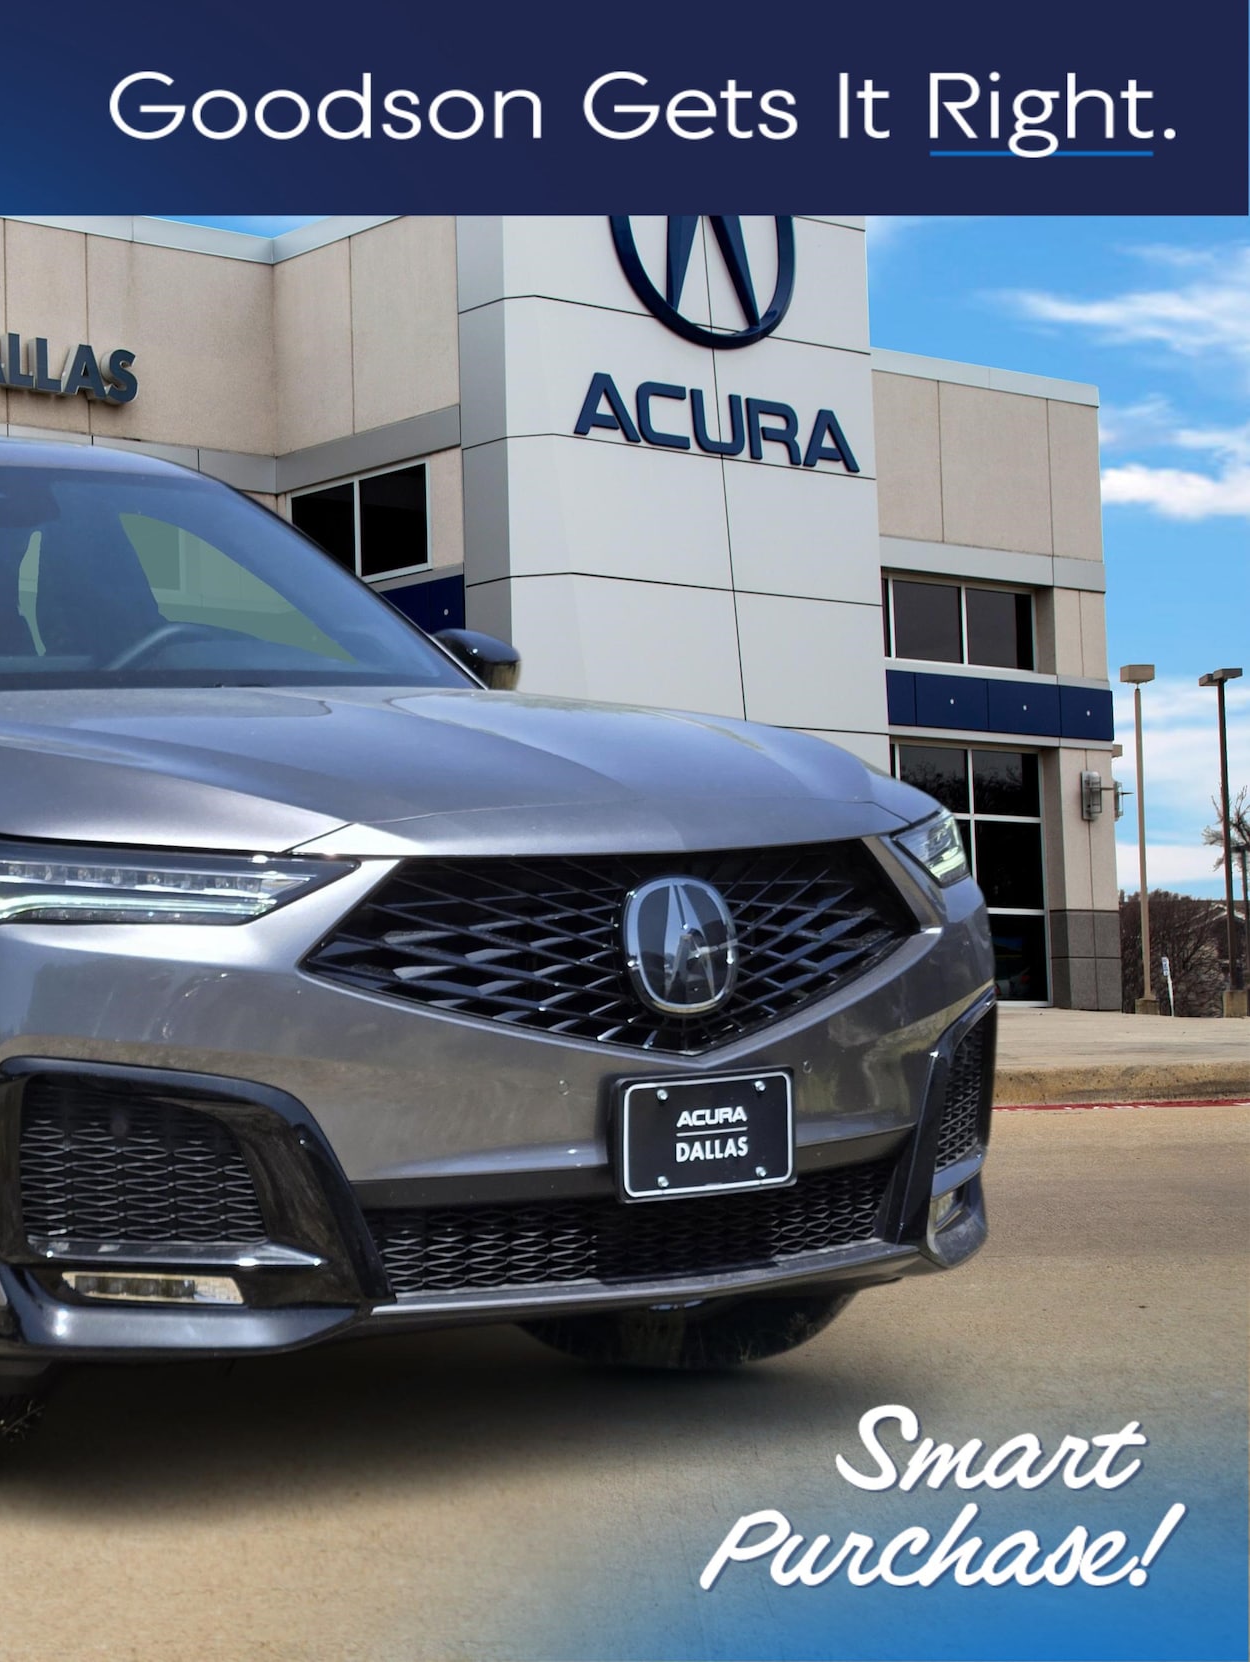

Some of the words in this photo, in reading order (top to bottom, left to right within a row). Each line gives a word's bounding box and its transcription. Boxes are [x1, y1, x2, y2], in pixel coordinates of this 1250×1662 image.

[573, 372, 861, 474] ACURA
[676, 1106, 748, 1128] ACURA
[675, 1136, 749, 1163] DALLAS
